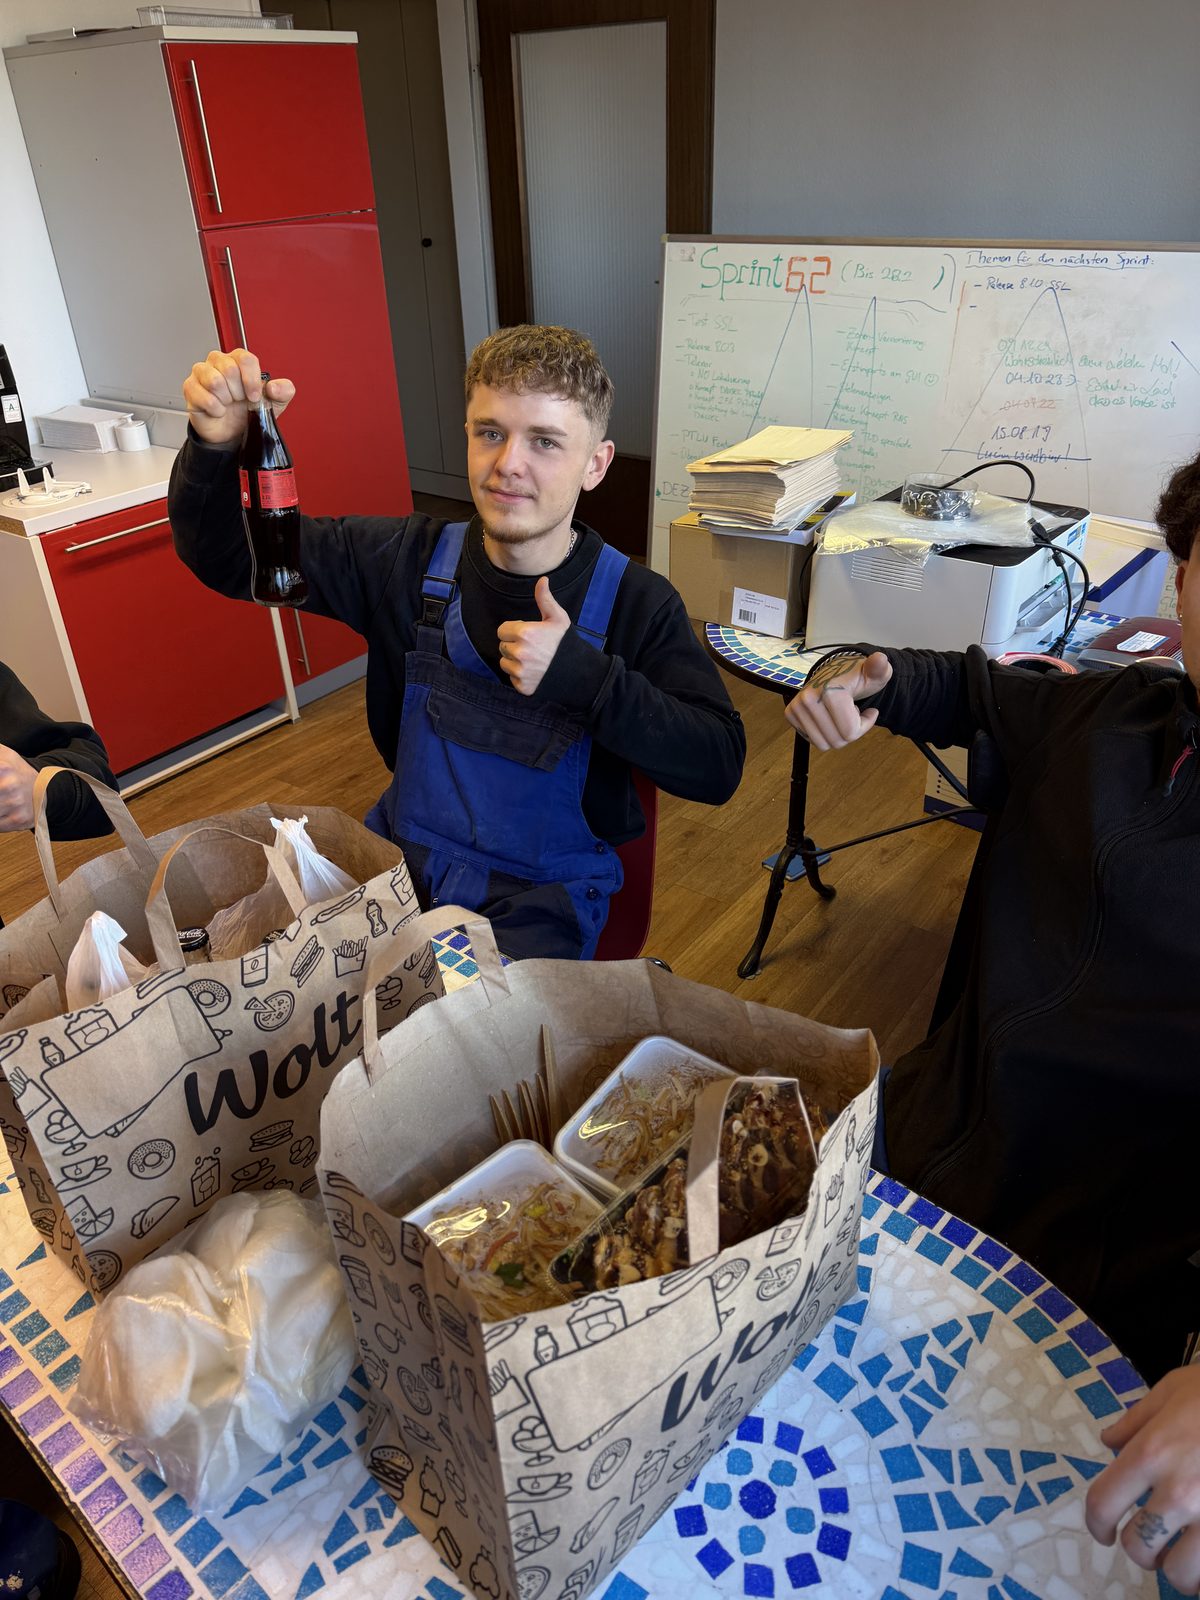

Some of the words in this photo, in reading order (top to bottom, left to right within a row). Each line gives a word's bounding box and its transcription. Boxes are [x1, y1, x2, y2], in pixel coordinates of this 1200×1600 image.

[967, 250, 1012, 263] Themen
[1060, 252, 1109, 265] nächsten
[700, 246, 785, 301] Sprint
[785, 256, 832, 294] 62
[986, 276, 1015, 290] Release
[991, 425, 1051, 442] 15.08.19
[185, 990, 362, 1136] Wolt
